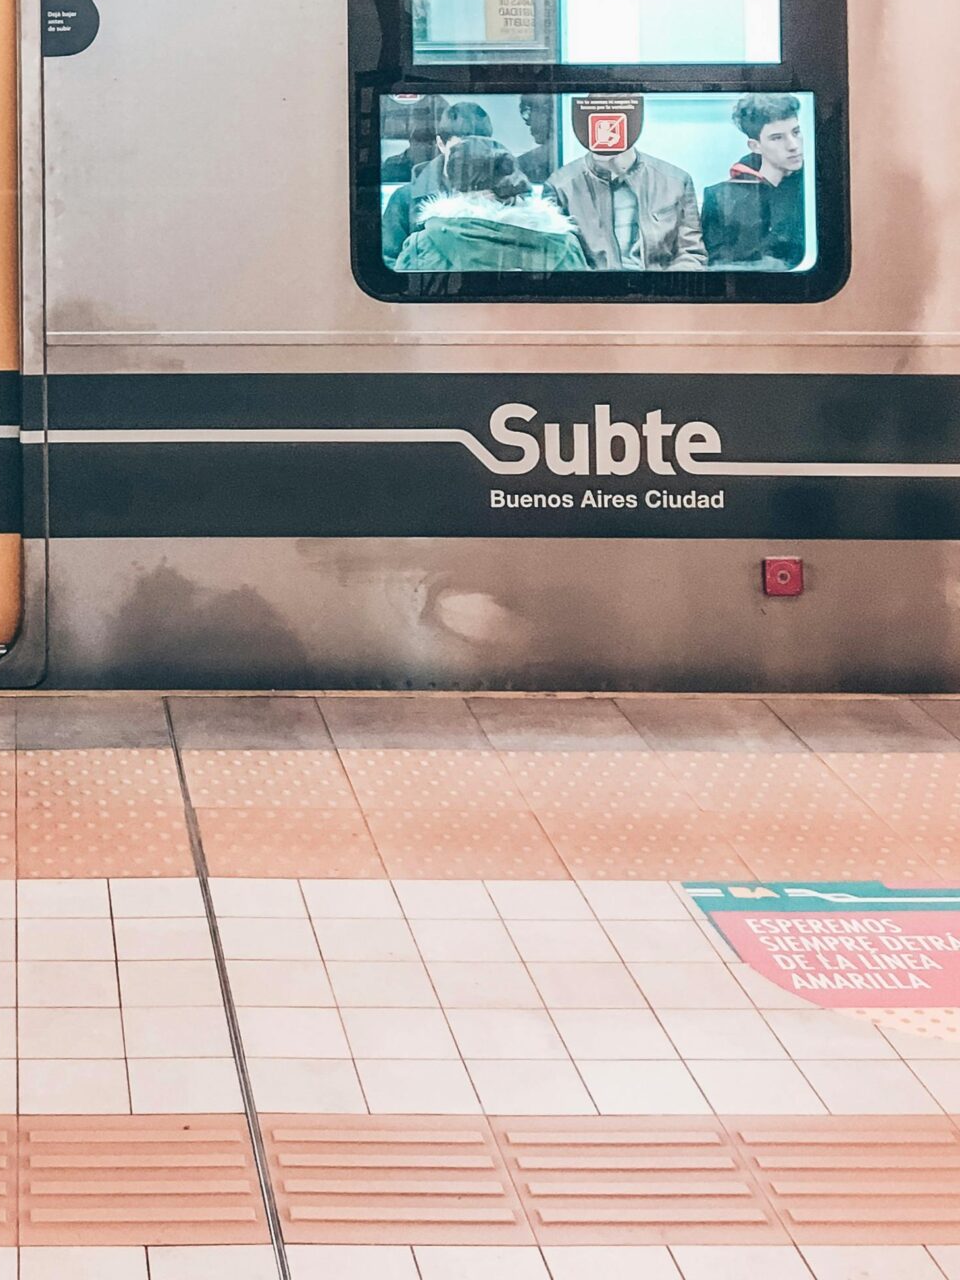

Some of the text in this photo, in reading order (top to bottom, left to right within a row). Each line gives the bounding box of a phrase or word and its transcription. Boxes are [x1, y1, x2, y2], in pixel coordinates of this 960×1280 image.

[489, 402, 722, 476] Subte
[490, 489, 725, 509] Buenos Aires Ciudad
[745, 918, 903, 934] ESPEREMOS
[758, 932, 960, 952] SIEMPRE DETRÁ
[773, 951, 944, 970] DE LA LÍNEA
[791, 973, 931, 990] AMARILLA
